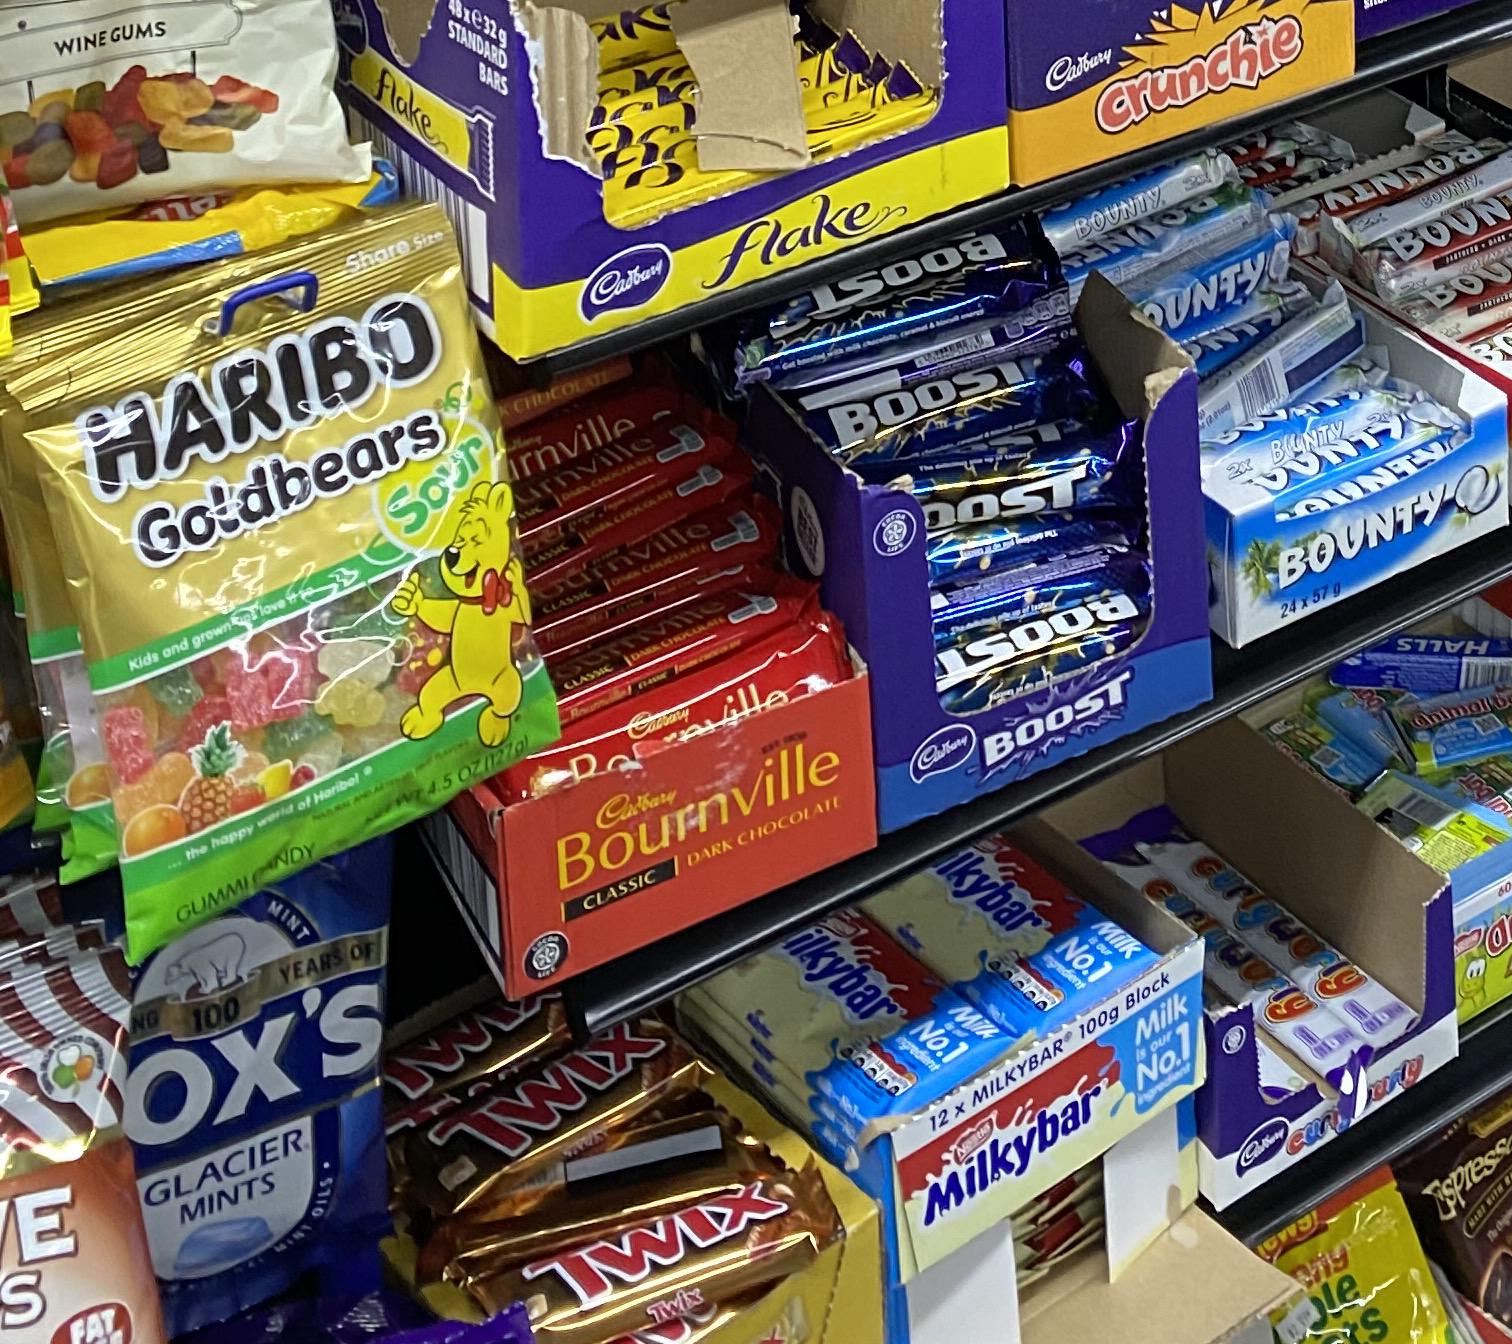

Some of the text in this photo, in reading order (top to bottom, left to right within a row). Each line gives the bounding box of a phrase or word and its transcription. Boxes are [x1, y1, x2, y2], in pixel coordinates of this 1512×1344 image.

[54, 20, 166, 56] WINE GUMS
[447, 19, 508, 68] STANDARD
[1096, 14, 1302, 134] crunchie
[478, 67, 508, 95] BARS
[346, 228, 445, 272] Share Size
[78, 298, 439, 498] HARIBO
[827, 360, 1029, 449] BOOST
[132, 410, 445, 565] Goldbears
[386, 434, 487, 536] Sour
[1278, 483, 1451, 591] BOUNTY
[1280, 601, 1298, 619] 24
[1312, 588, 1328, 607] 57
[1332, 584, 1342, 600] g
[128, 639, 189, 673] Kids and
[1395, 636, 1490, 656] HALLS
[982, 672, 1132, 766] BOOST
[556, 750, 840, 891] Bournville
[582, 794, 841, 911] CLASSIC DARK CHOCOLATE
[266, 900, 310, 942] MINT
[1497, 881, 1512, 897] 60
[191, 941, 377, 1032] 100 YEARS OF
[1135, 995, 1188, 1046] Milk
[929, 1106, 949, 1132] 12
[954, 1104, 965, 1117] x
[1079, 1006, 1120, 1041] 100g
[1126, 972, 1170, 1011] Block
[1136, 1033, 1172, 1062] is our
[1136, 1028, 1189, 1092] No.1
[142, 1128, 304, 1209] GLACIER
[923, 1086, 1103, 1227] Milkybar
[179, 1174, 276, 1226] MINTS
[523, 1181, 789, 1311] TWIX
